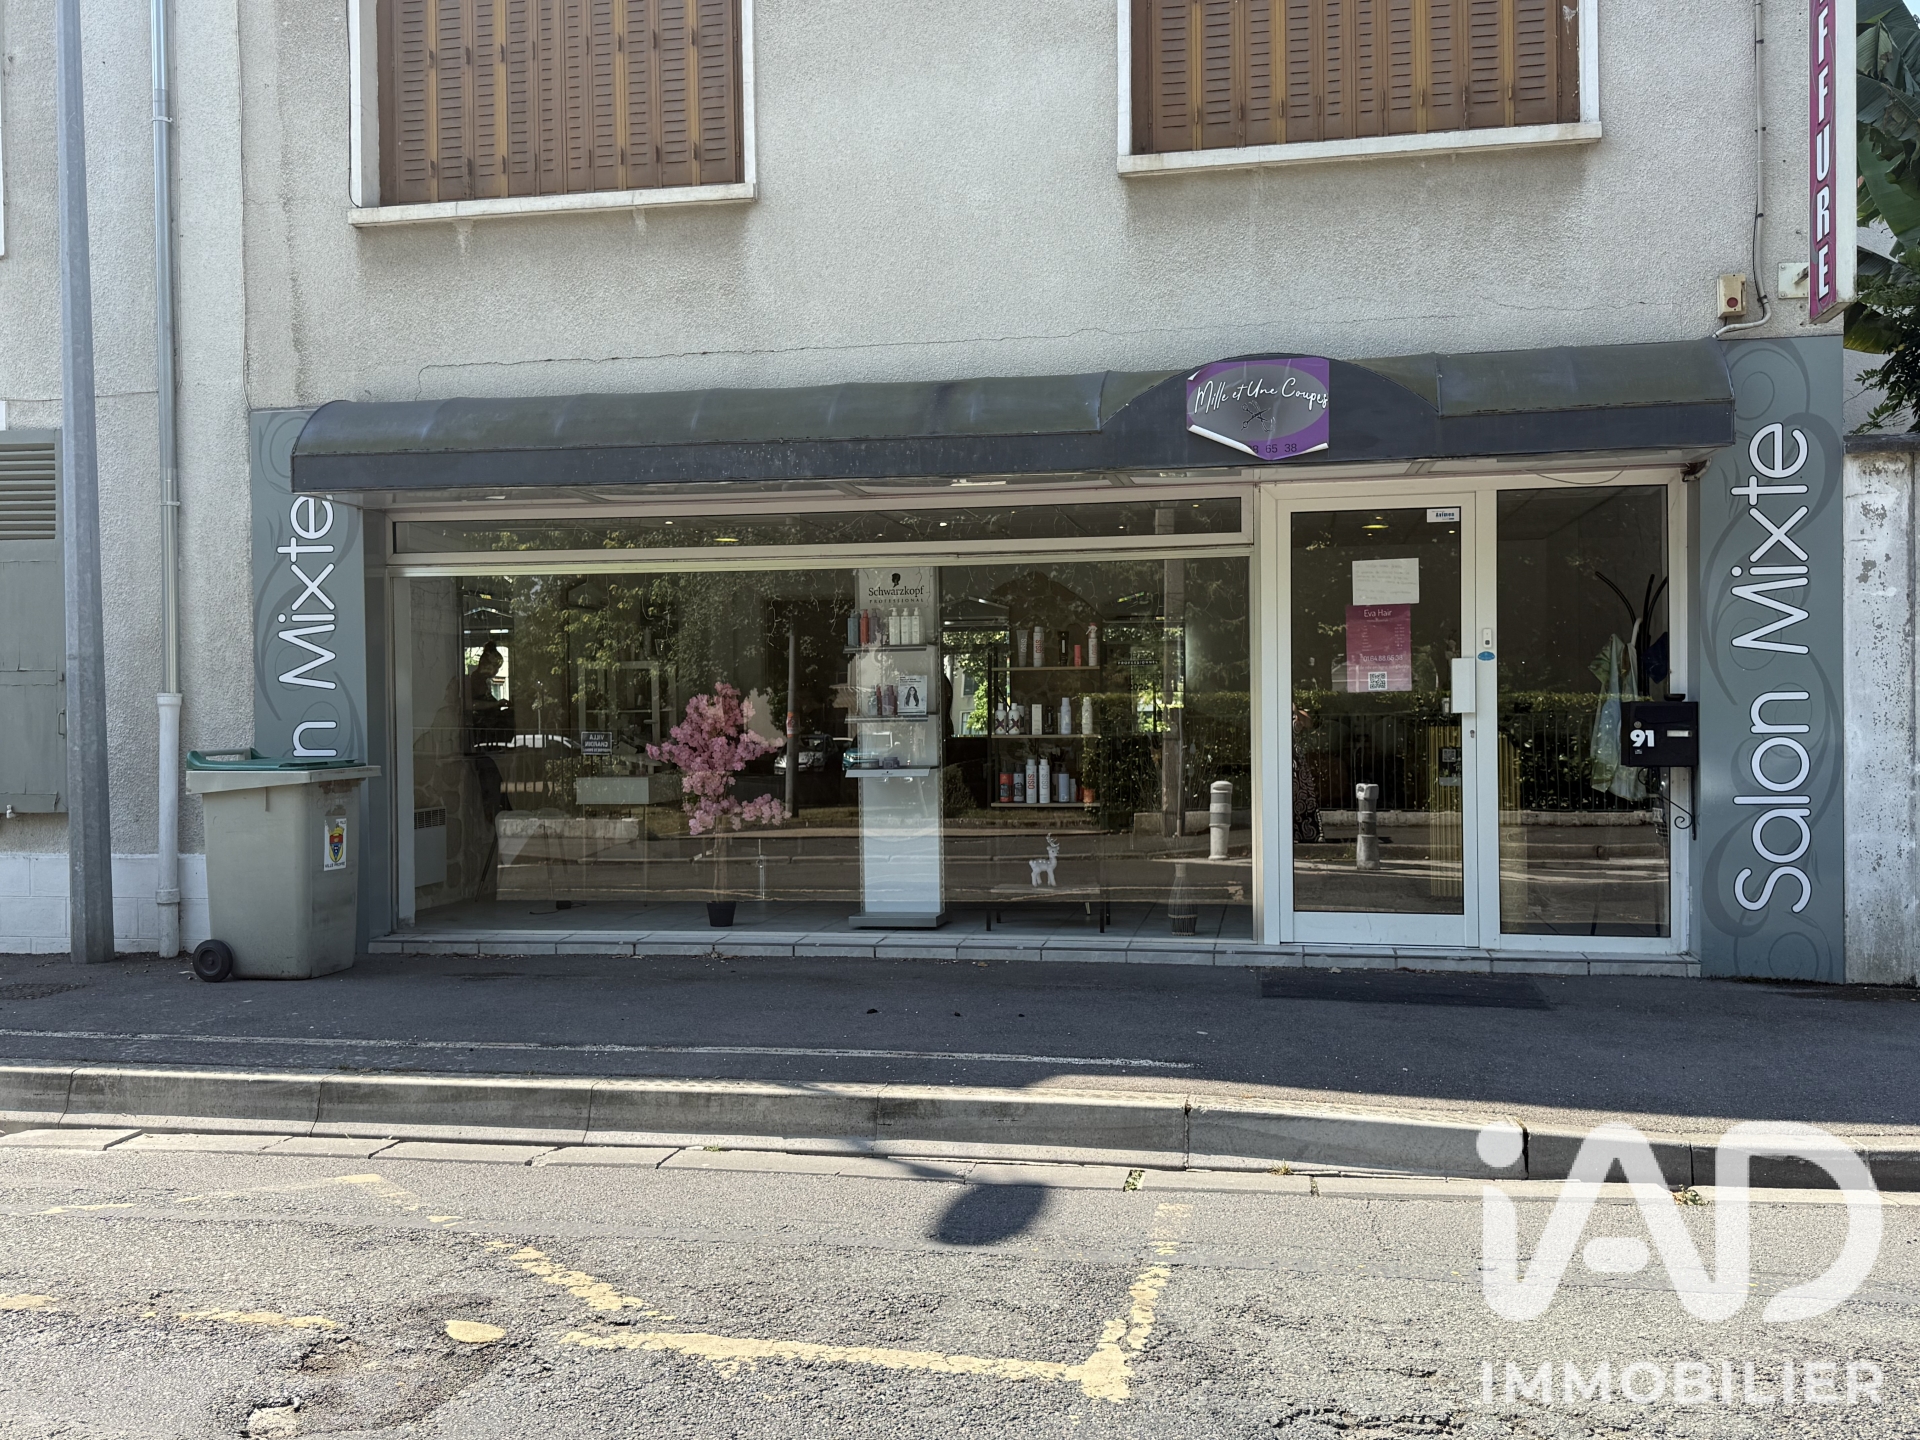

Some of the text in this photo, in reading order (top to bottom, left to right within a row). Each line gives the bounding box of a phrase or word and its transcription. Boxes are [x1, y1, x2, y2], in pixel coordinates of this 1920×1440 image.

[1815, 0, 1831, 299] FFURE
[1194, 377, 1329, 414] Mille et Une Coupes
[1265, 443, 1278, 454] 65
[1284, 442, 1298, 453] 38
[1730, 421, 1810, 656] Mixte
[276, 494, 337, 690] Mixte
[868, 585, 925, 598] Schwarzkopf
[1363, 608, 1393, 618] Eva Hair
[1128, 683, 1150, 691] 2026
[1630, 729, 1655, 747] 91
[1732, 690, 1812, 913] Salon
